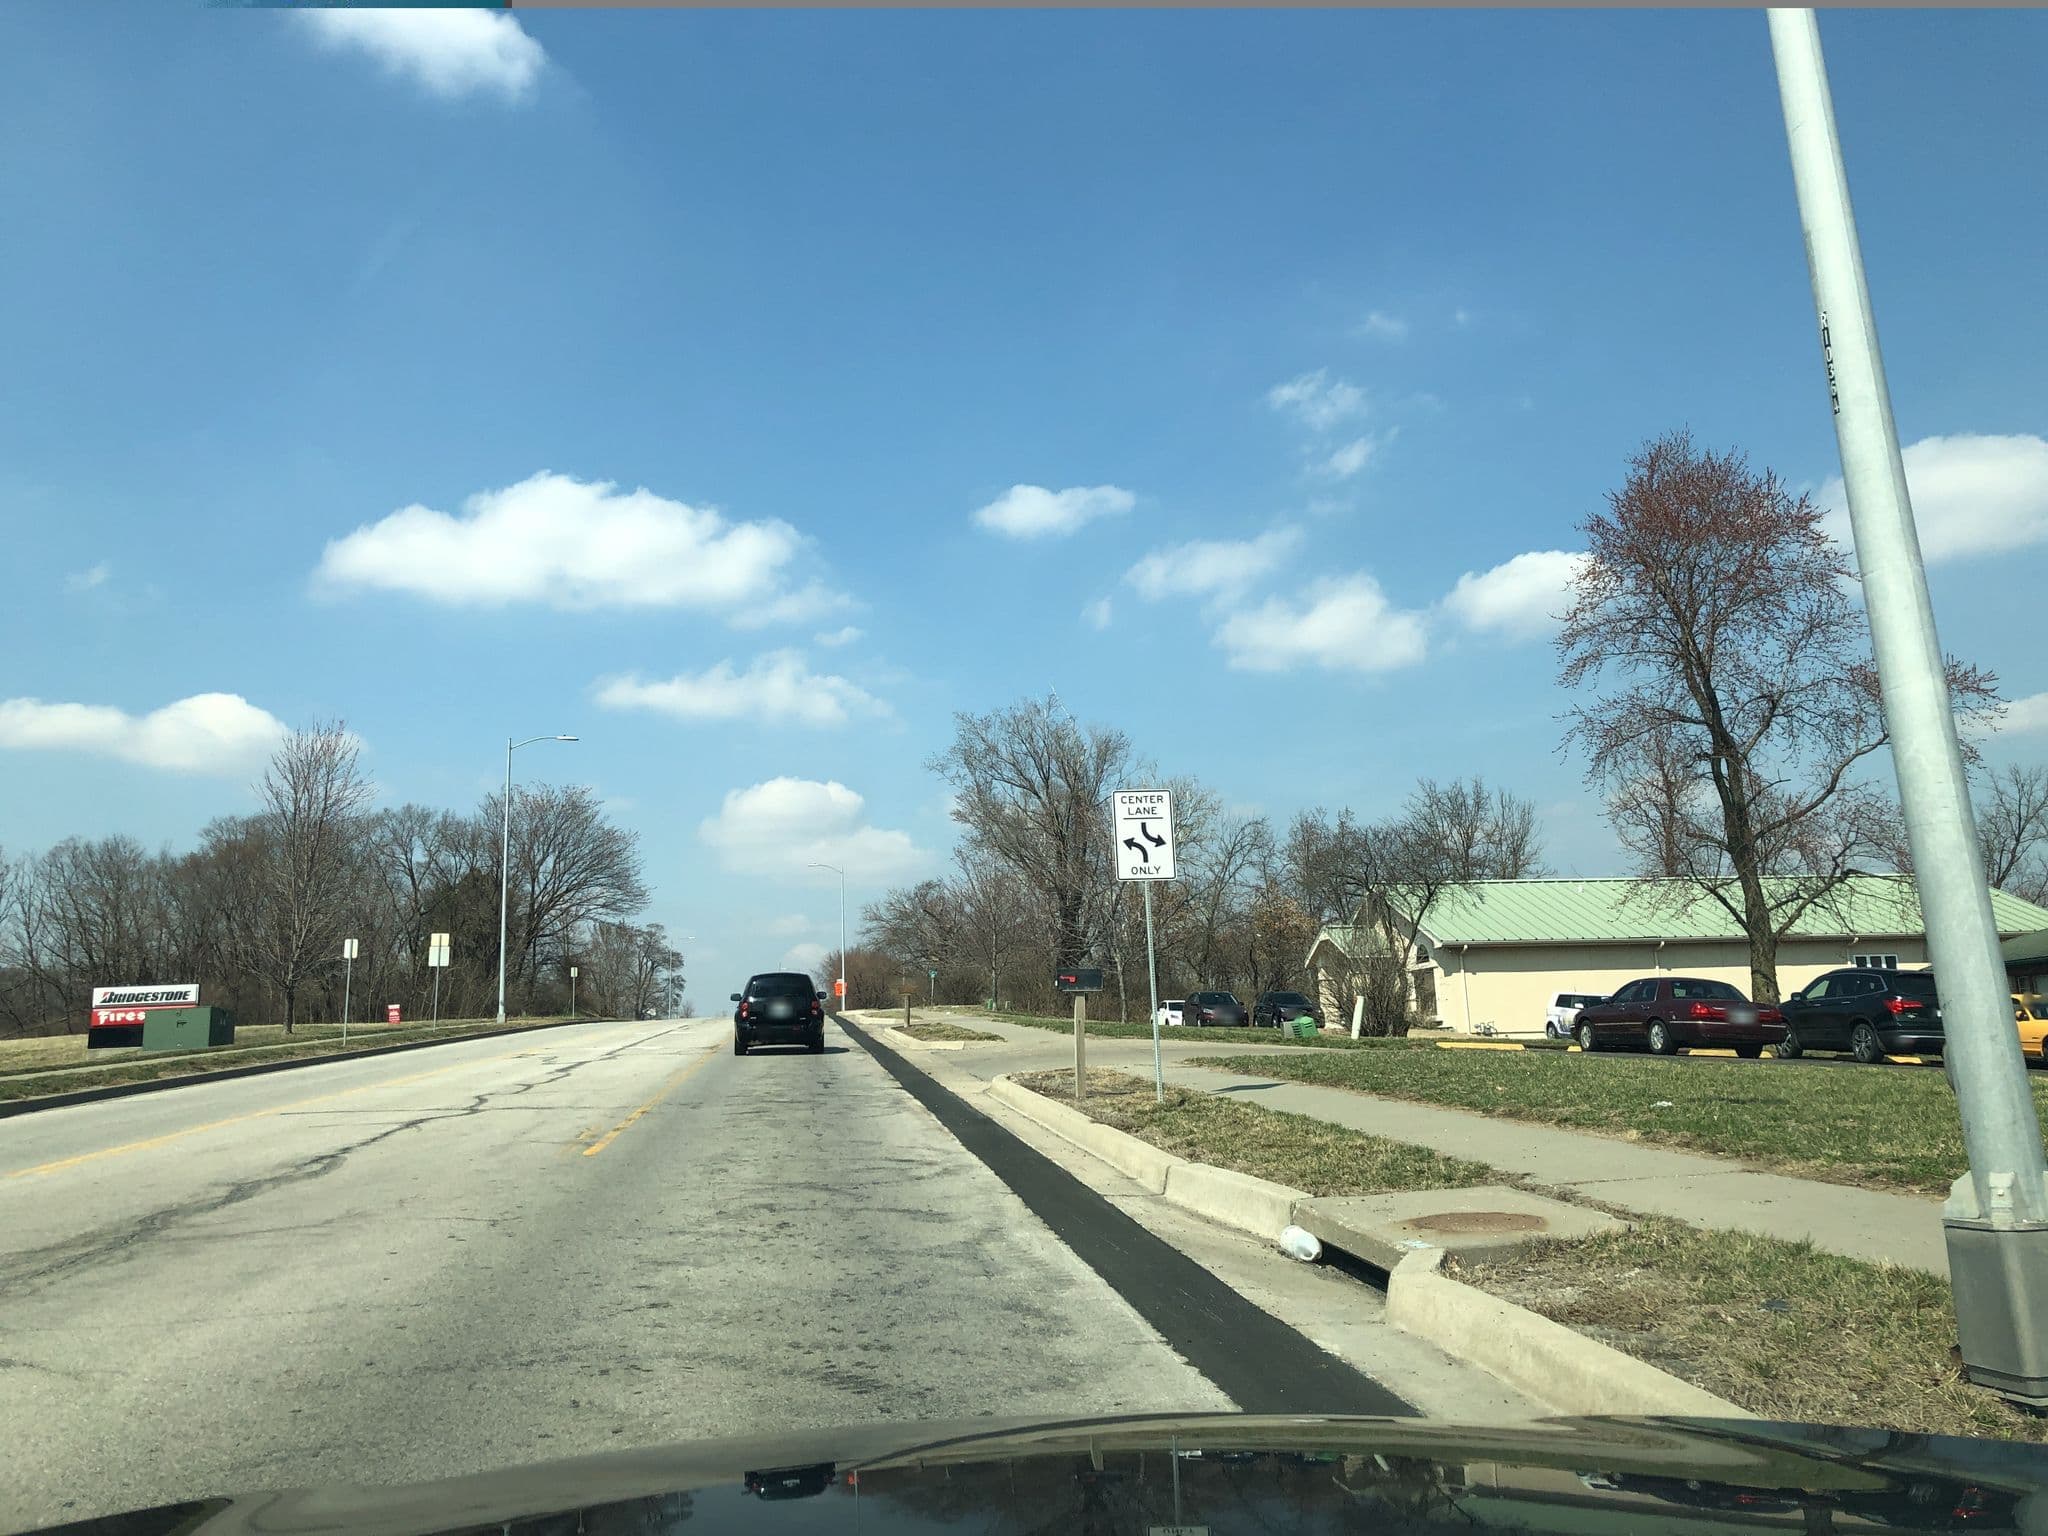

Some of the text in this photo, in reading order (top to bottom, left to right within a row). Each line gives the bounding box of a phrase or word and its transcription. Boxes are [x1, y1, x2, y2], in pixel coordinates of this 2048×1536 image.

[1120, 795, 1164, 805] CENTER
[1127, 806, 1158, 816] LANE
[1130, 865, 1161, 875] ONLY
[99, 990, 192, 1004] BRIDGESTONE
